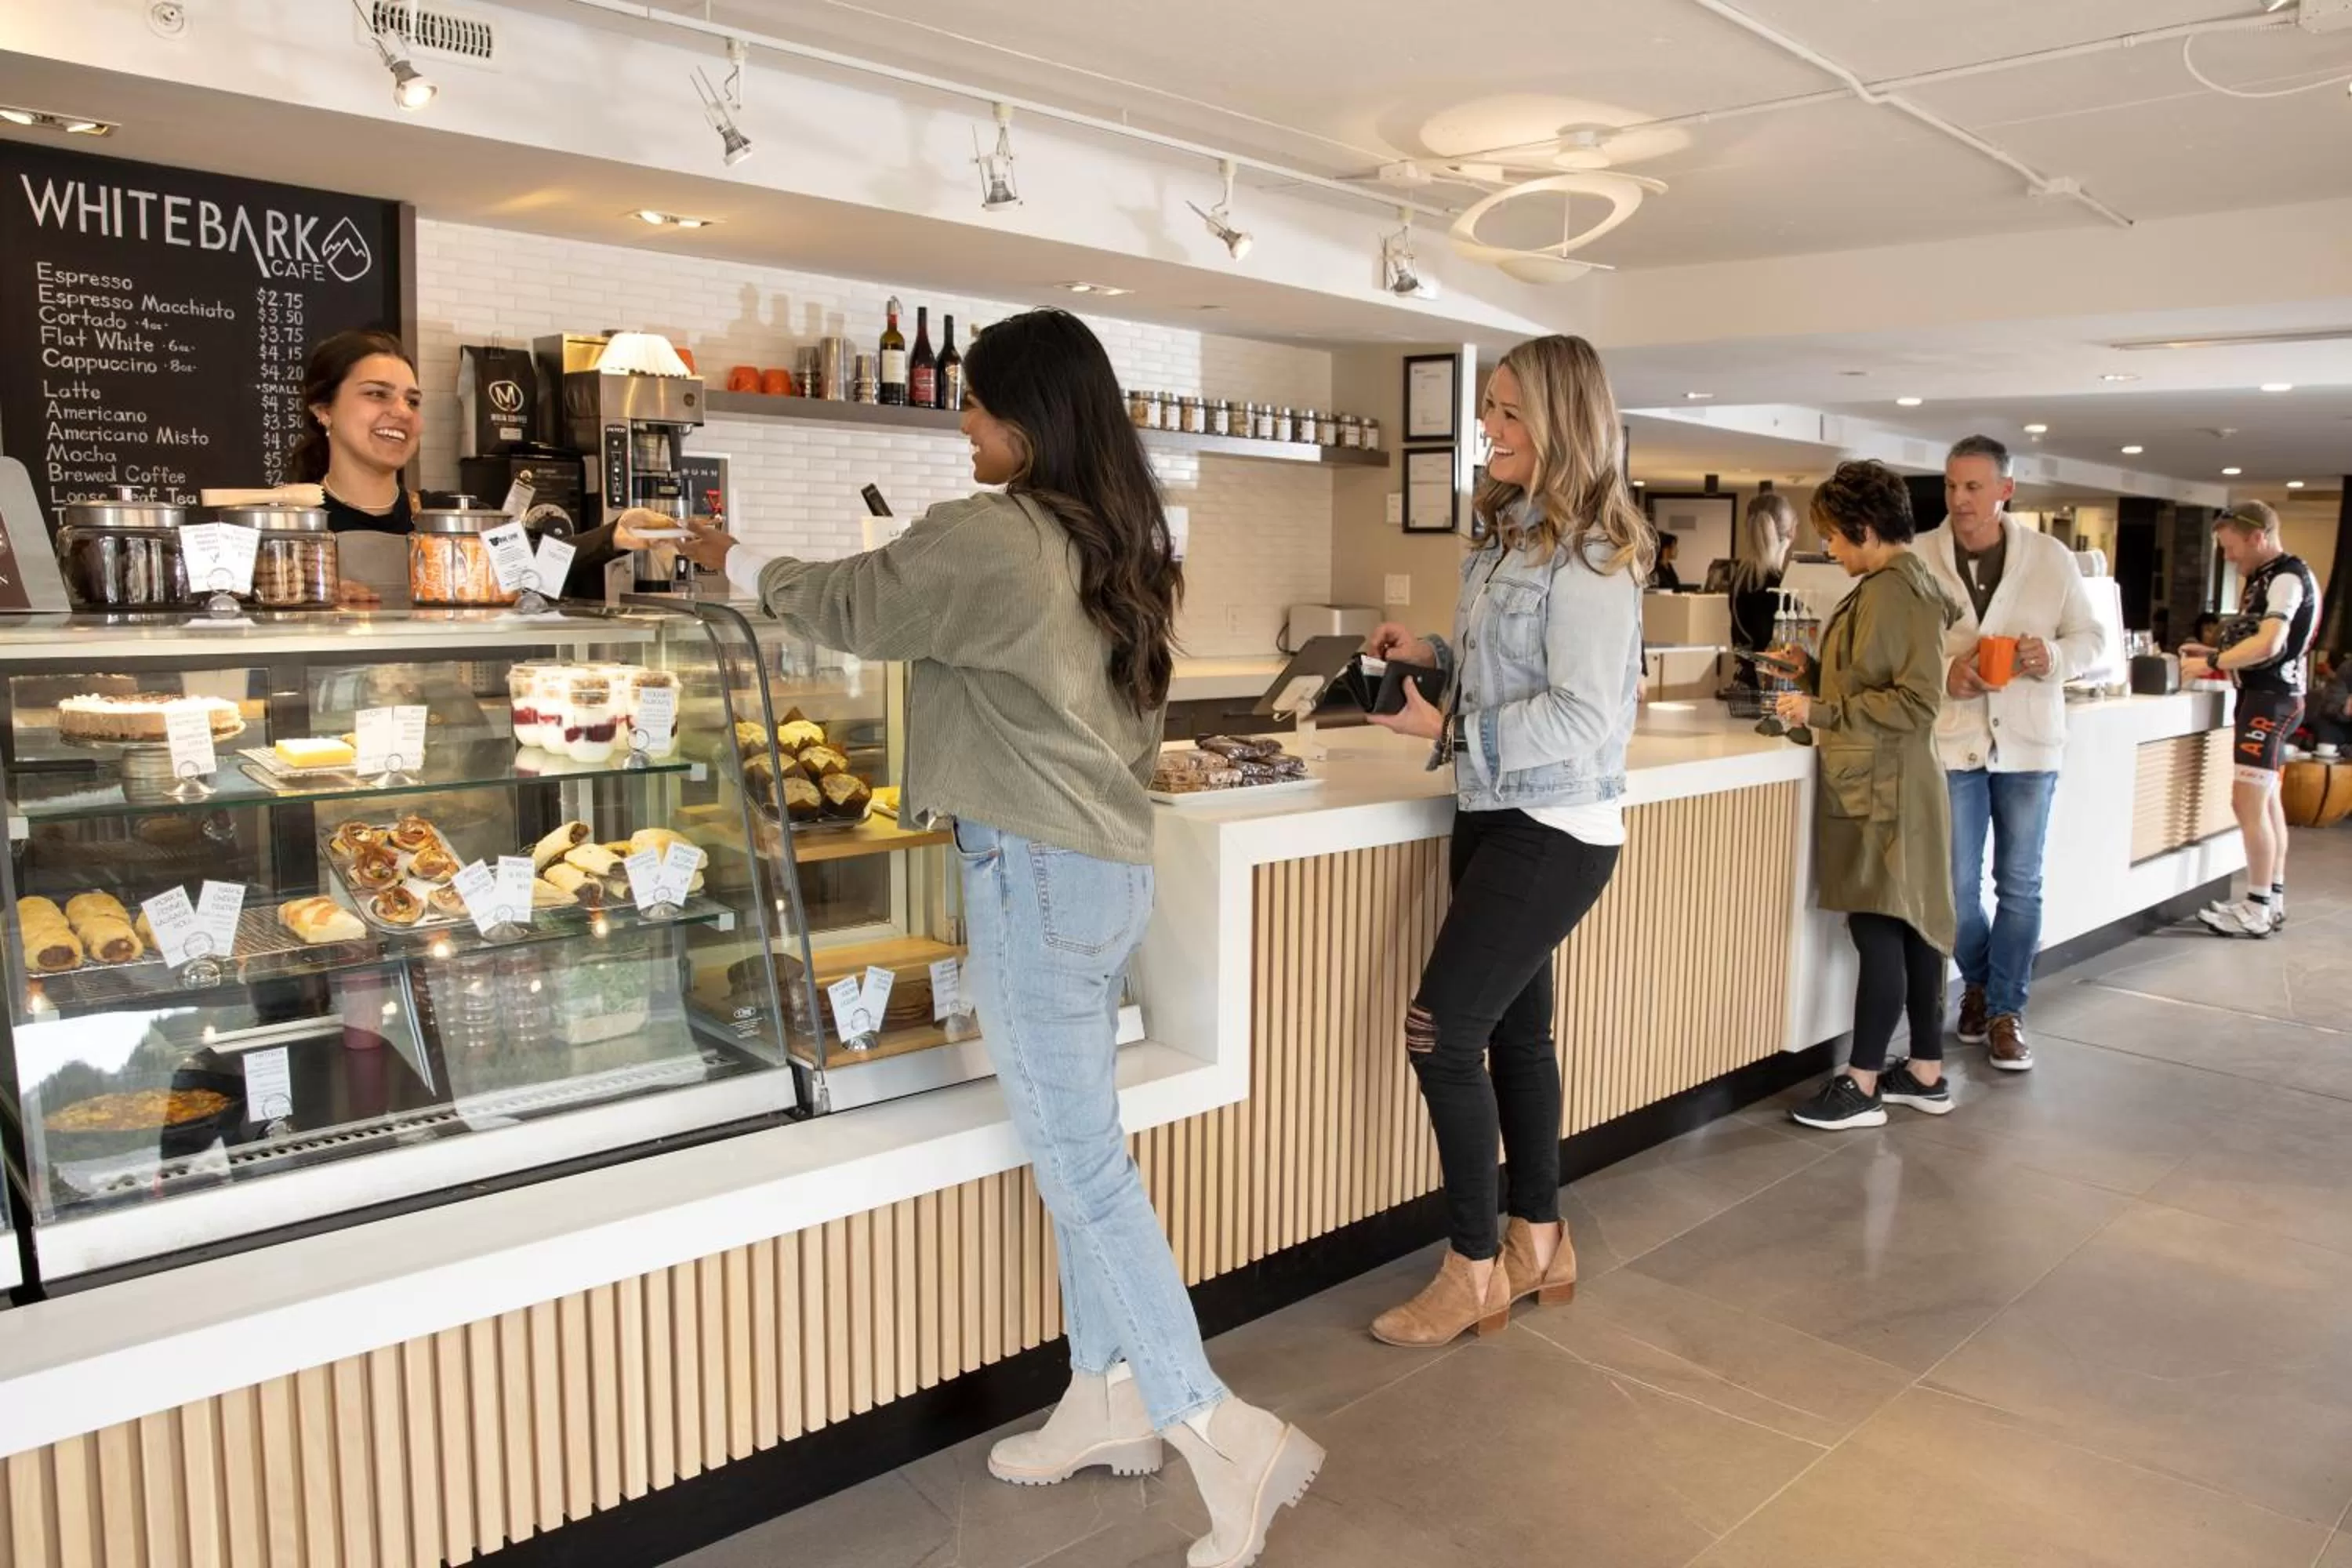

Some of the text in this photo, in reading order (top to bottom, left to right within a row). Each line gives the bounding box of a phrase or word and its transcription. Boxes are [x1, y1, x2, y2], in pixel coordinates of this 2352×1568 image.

[20, 174, 319, 278] WHITEBARK
[37, 261, 132, 291] Espresso
[270, 260, 326, 281] CAFE
[38, 283, 235, 320] Espresso Macchiato
[256, 287, 303, 309] $2.75
[38, 306, 126, 330] Cortado
[257, 307, 303, 325] $3.50
[41, 325, 88, 347] Flat
[96, 329, 154, 352] White
[259, 325, 303, 343] $3.75
[42, 347, 158, 375] Cappuccino
[259, 343, 303, 361] $4.15
[260, 362, 303, 381] $4.20
[43, 379, 101, 400] Latte
[495, 385, 517, 406] M
[45, 401, 147, 423] Americano
[46, 421, 209, 445] Americano Misto
[45, 443, 117, 462] Mocha
[48, 462, 186, 484] Brewed Coffee
[166, 487, 198, 505] Tea
